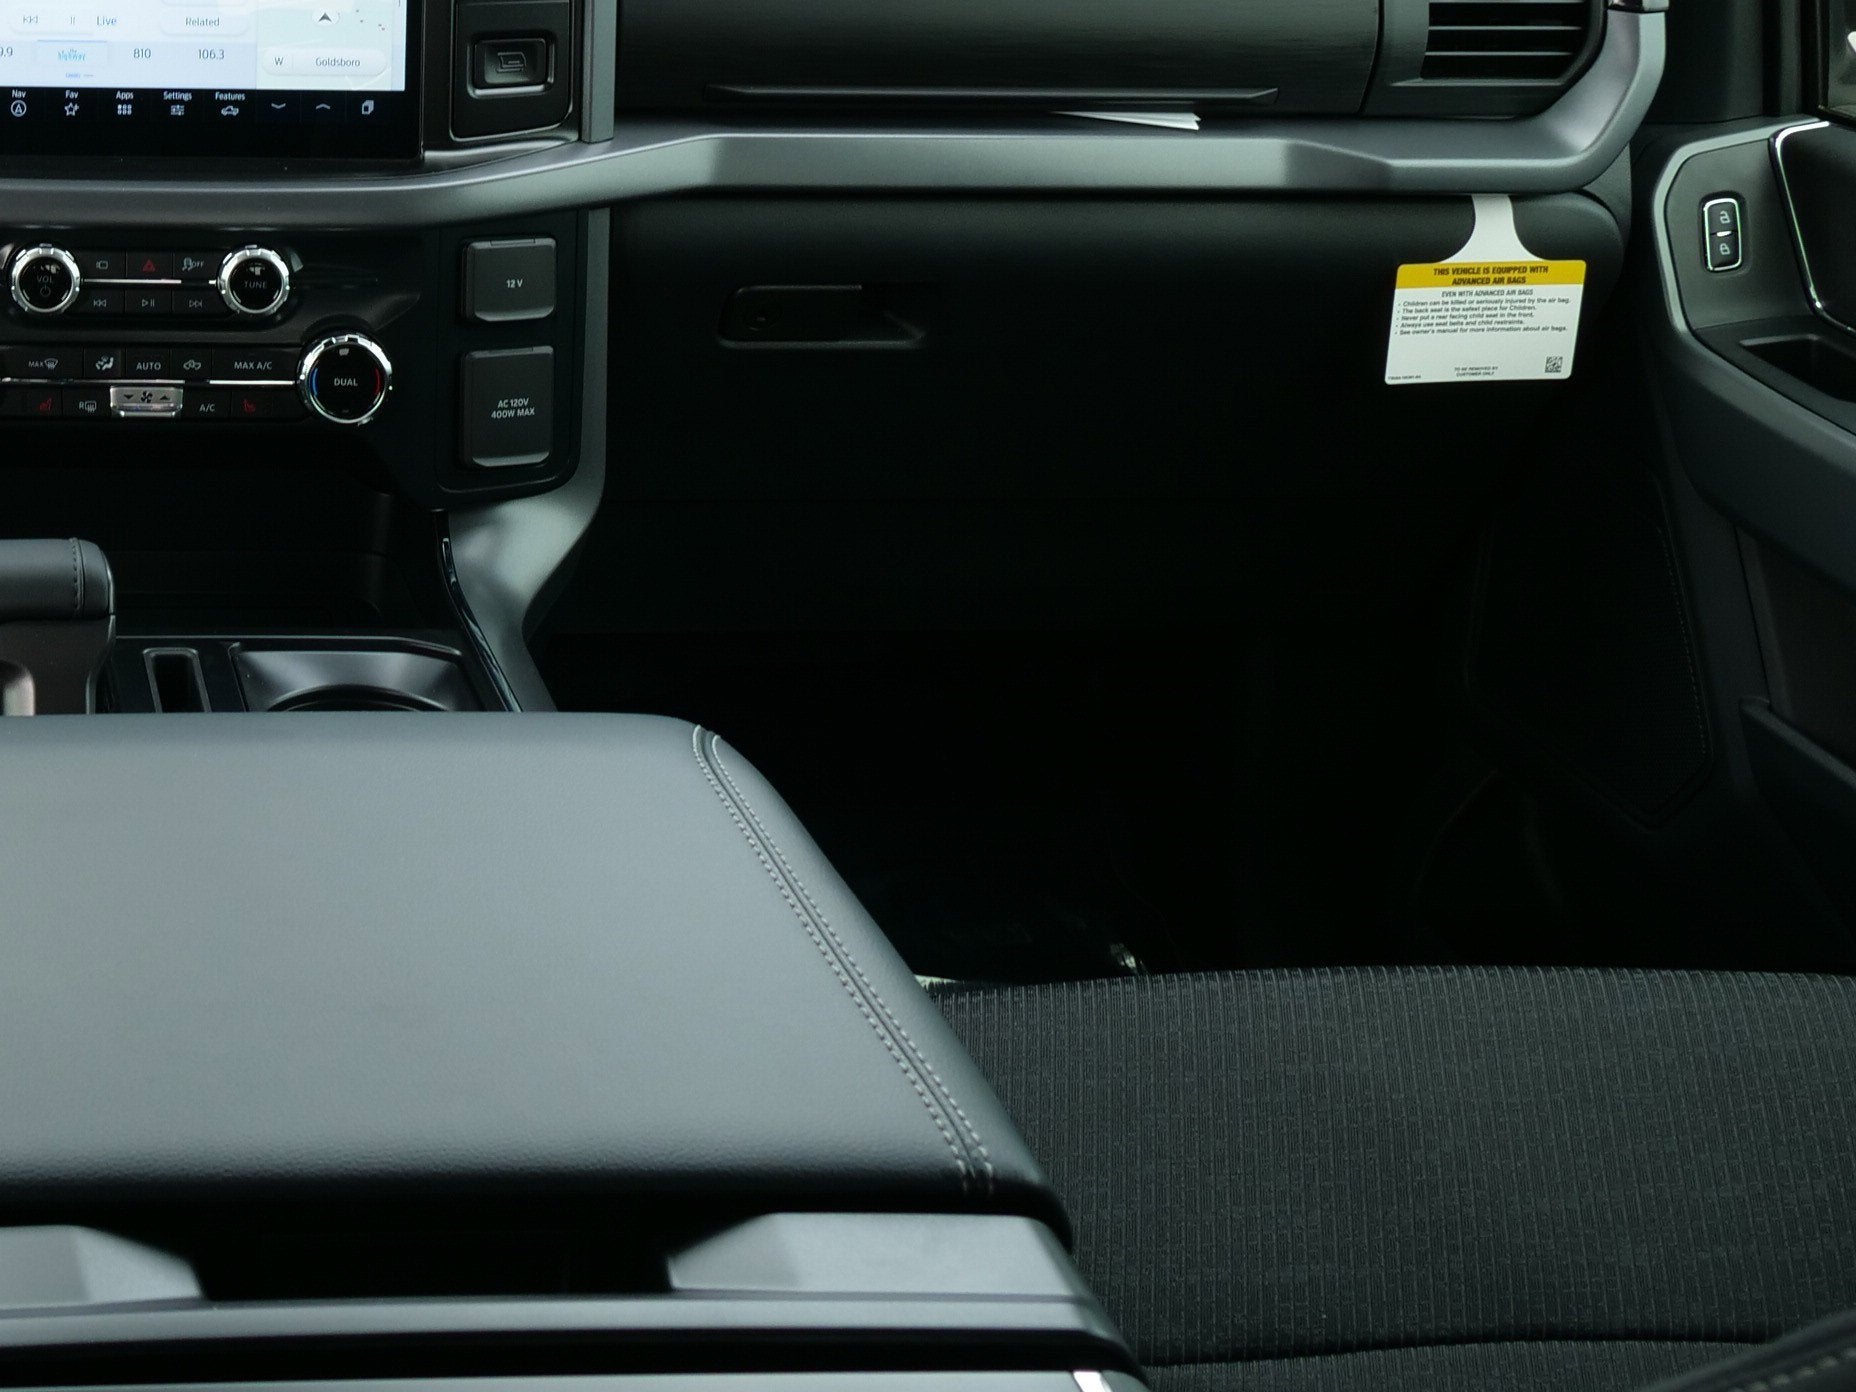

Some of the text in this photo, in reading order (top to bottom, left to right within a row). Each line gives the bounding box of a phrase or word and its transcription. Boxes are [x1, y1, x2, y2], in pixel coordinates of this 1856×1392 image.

[96, 15, 118, 26] Live
[185, 16, 220, 27] Related
[133, 48, 152, 59] 810
[198, 49, 225, 60] 106.3
[274, 56, 361, 68] W Goldsboro
[12, 89, 26, 98] Nav
[65, 90, 79, 99] Fav
[115, 90, 134, 100] Apps
[163, 91, 192, 102] Settings
[215, 92, 246, 102] Features
[1433, 266, 1549, 276] THIS VEHICLE IS EQUIPPED WITH
[506, 278, 524, 288] 12 V
[1451, 276, 1526, 286] ADVANCED AIR BAGS
[1441, 290, 1457, 298] EVEN
[1474, 289, 1505, 297] ADVANCED
[1476, 299, 1504, 307] seriously
[1527, 298, 1536, 306] by
[1557, 297, 1571, 305] bag.
[1551, 325, 1567, 333] bags.
[136, 361, 162, 371] AUTO
[233, 360, 273, 371] MAX A/C
[333, 377, 359, 387] DUAL
[199, 402, 216, 413] A/C
[497, 397, 530, 409] AC 120V
[490, 407, 535, 419] 400W MAX
